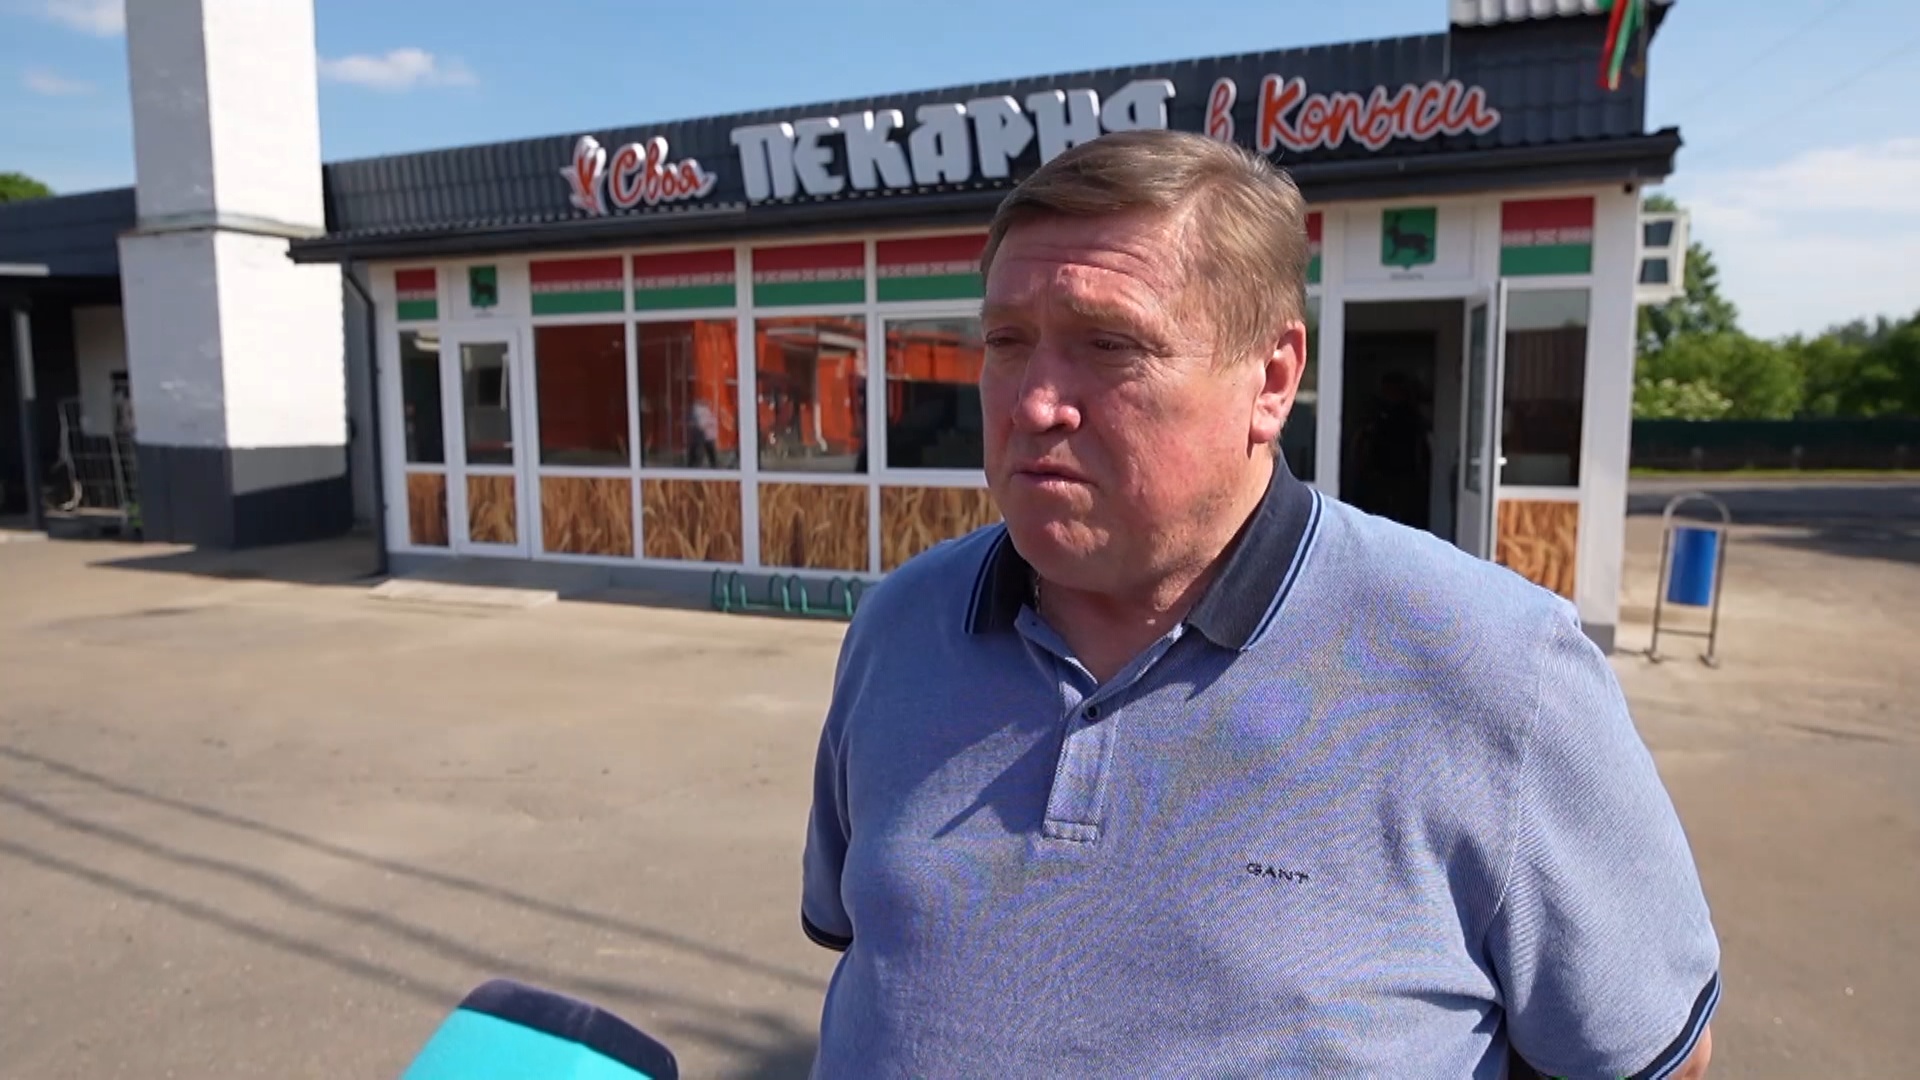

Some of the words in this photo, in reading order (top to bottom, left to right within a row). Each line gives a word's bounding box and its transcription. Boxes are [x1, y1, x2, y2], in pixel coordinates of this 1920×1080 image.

[608, 135, 718, 208] Своя
[1256, 73, 1501, 152] Копыси
[1246, 862, 1309, 884] GANT
